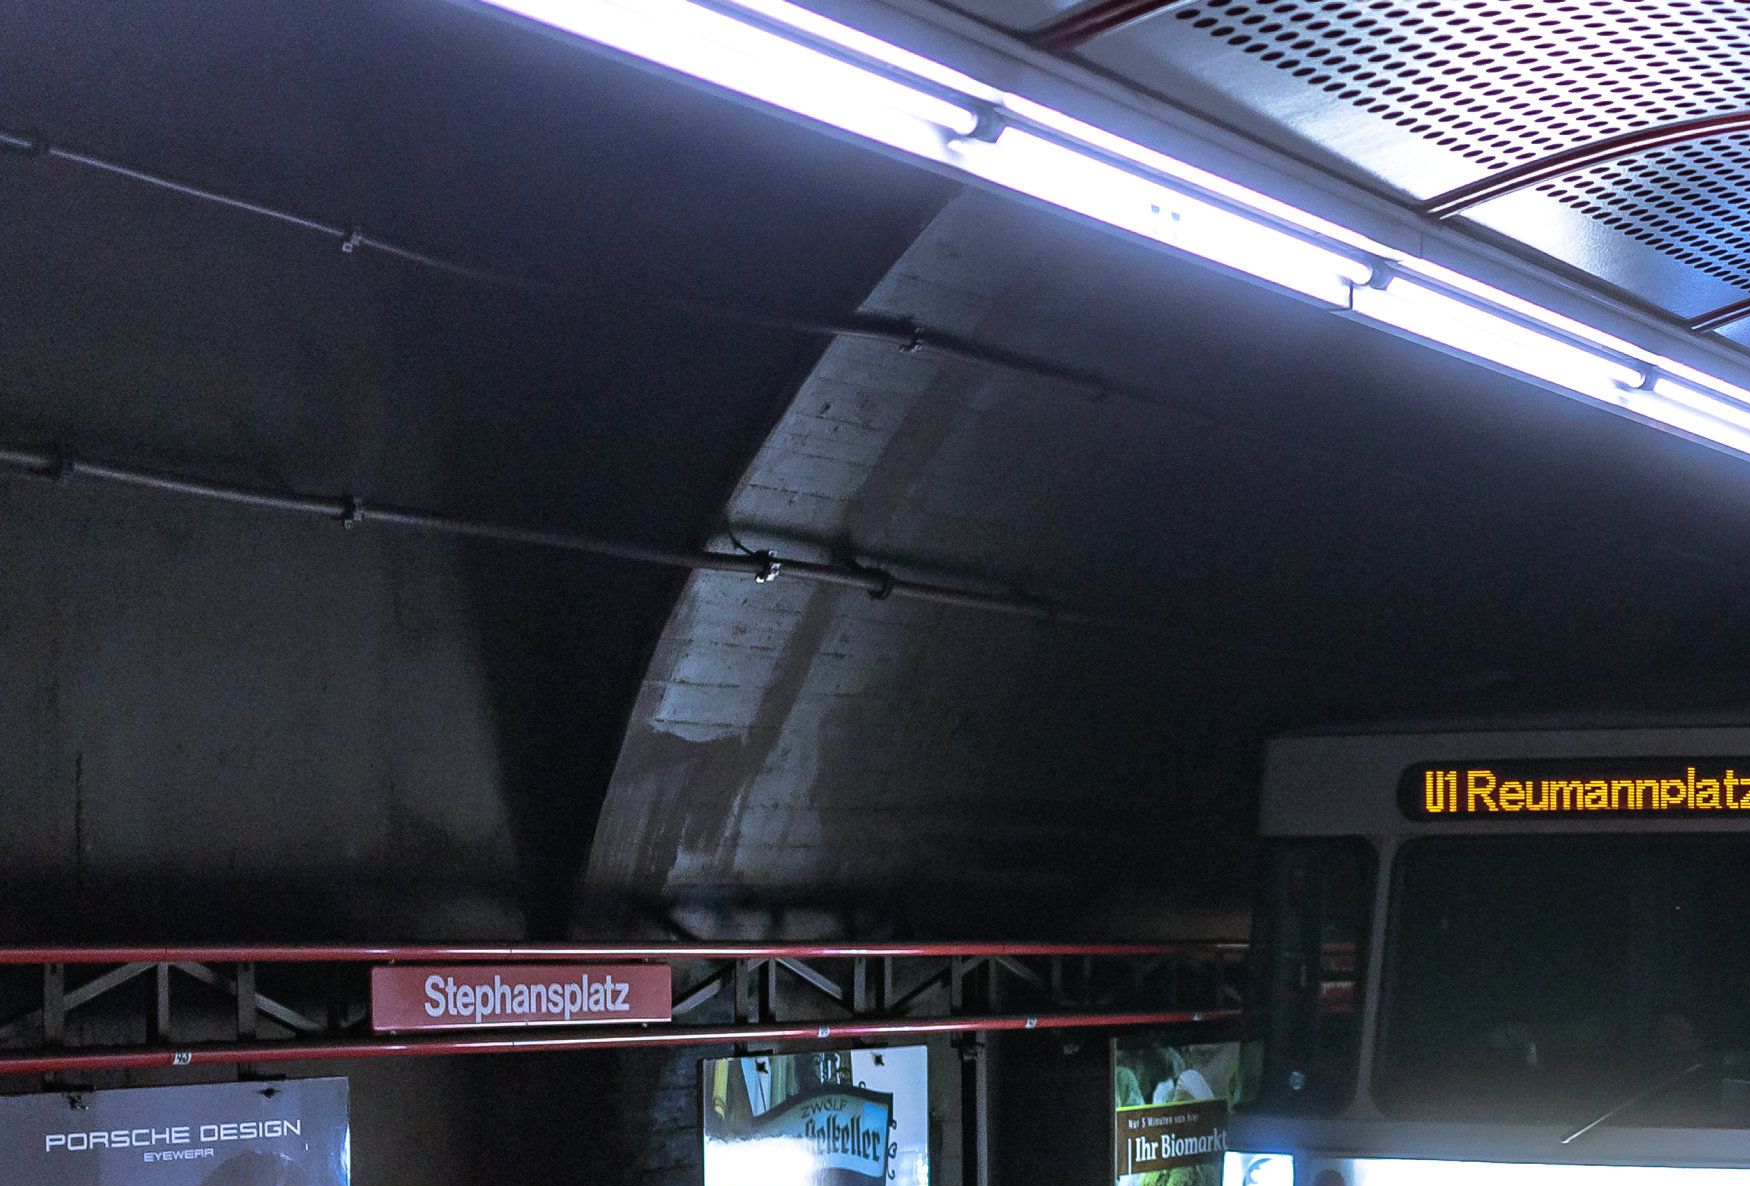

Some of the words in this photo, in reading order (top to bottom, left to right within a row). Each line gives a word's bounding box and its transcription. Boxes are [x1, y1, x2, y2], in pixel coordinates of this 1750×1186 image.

[1425, 770, 1457, 813] U1
[424, 973, 630, 1023] Stephansplatz
[801, 1097, 848, 1119] ZWÖLF
[1148, 1115, 1172, 1127] Minuten
[46, 1126, 190, 1152] PORSCHE
[200, 1119, 302, 1143] DESIGN
[1135, 1136, 1159, 1162] Ihr
[1161, 1128, 1228, 1160] Biomarkt
[143, 1148, 214, 1163] EYEWEAR
